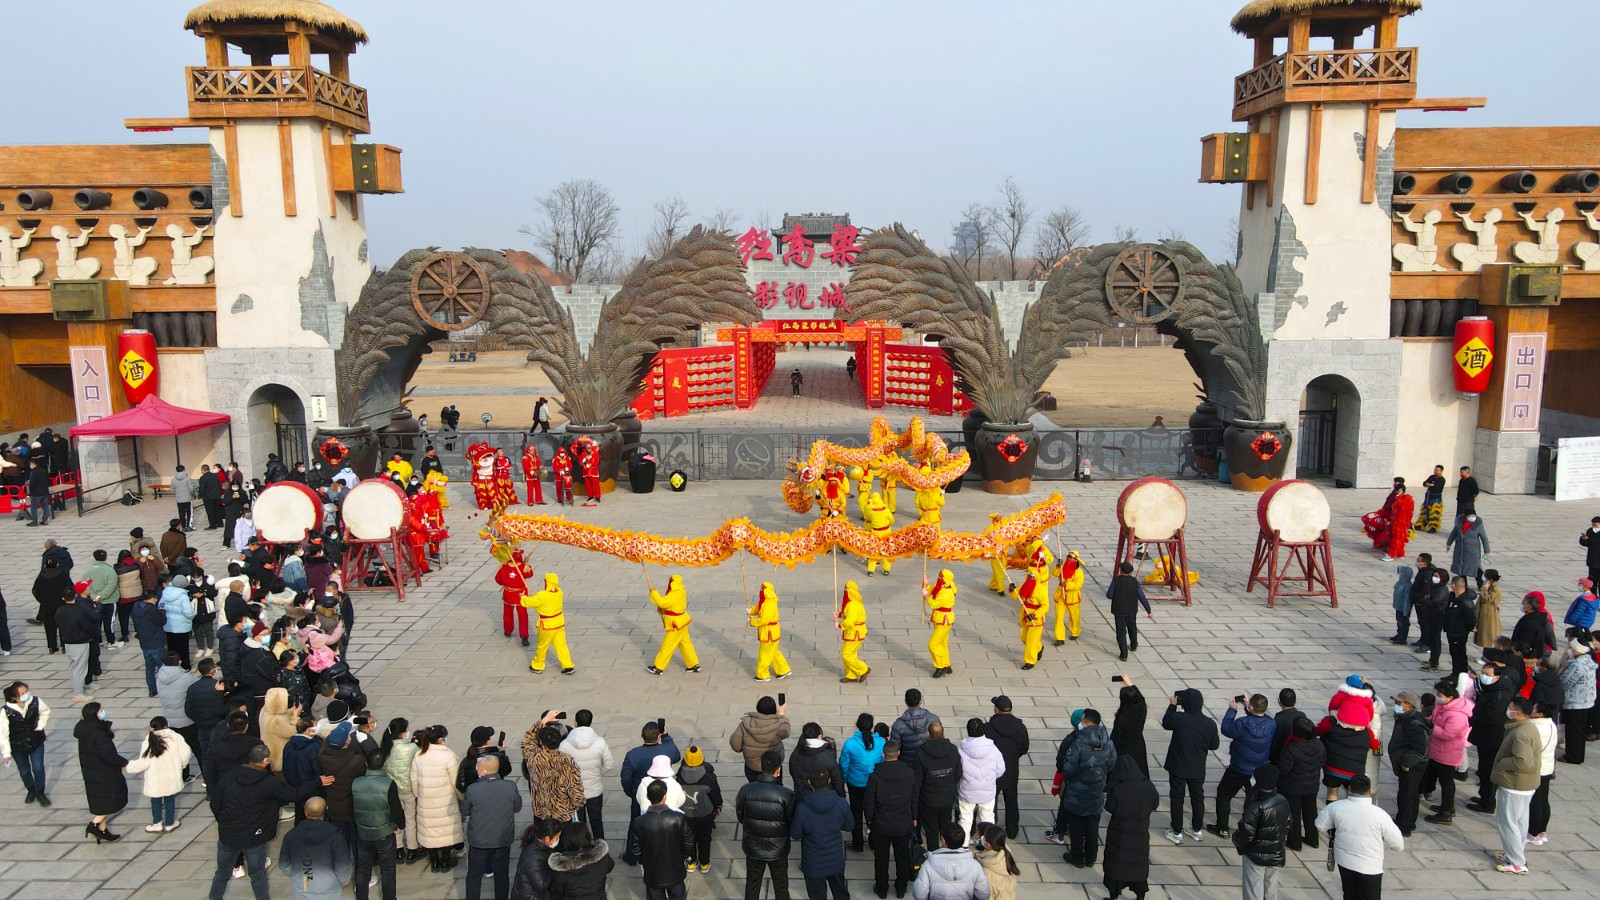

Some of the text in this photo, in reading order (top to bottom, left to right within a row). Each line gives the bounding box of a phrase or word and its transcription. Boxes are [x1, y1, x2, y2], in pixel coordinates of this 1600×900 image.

[737, 223, 863, 268] 红高粱
[750, 281, 853, 313] 影视城
[123, 358, 146, 381] 酒
[1461, 346, 1488, 370] 酒
[1515, 346, 1535, 390] 出口
[81, 359, 100, 401] 入口
